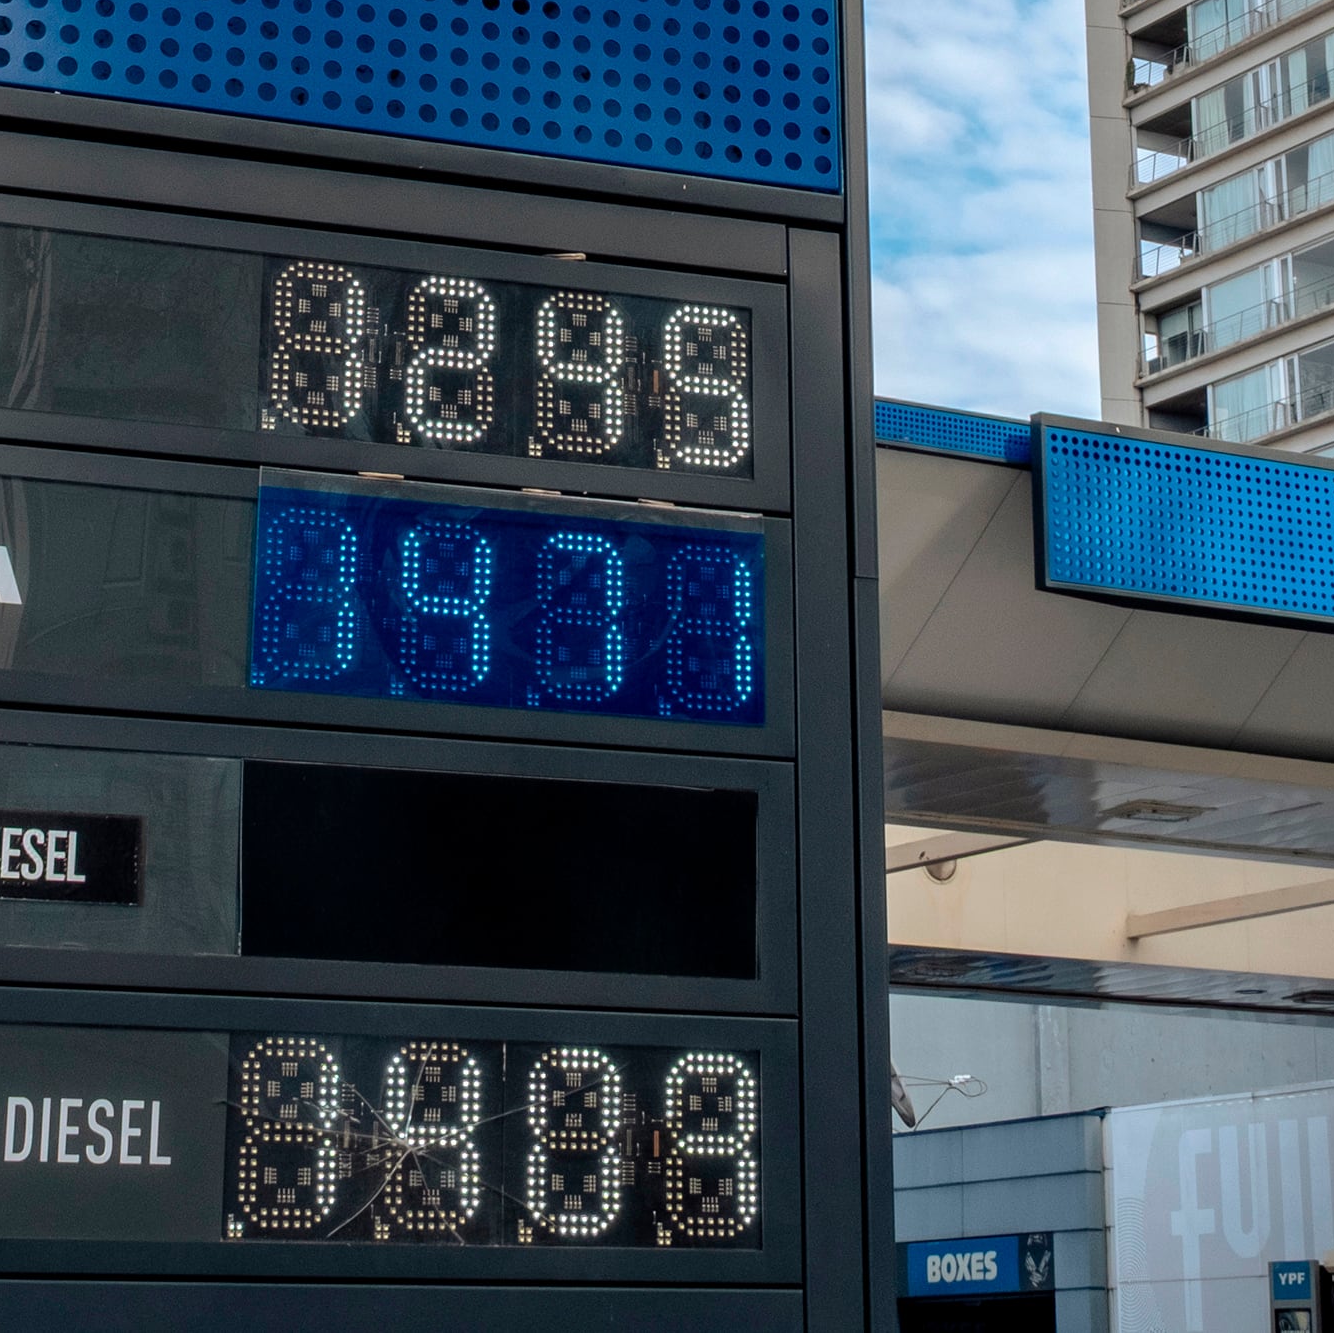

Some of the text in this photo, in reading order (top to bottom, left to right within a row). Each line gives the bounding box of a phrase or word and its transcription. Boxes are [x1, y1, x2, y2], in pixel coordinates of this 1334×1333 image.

[2, 1096, 172, 1167] DIESEL
[926, 1250, 998, 1284] BOXES
[1278, 1272, 1306, 1285] YPF
